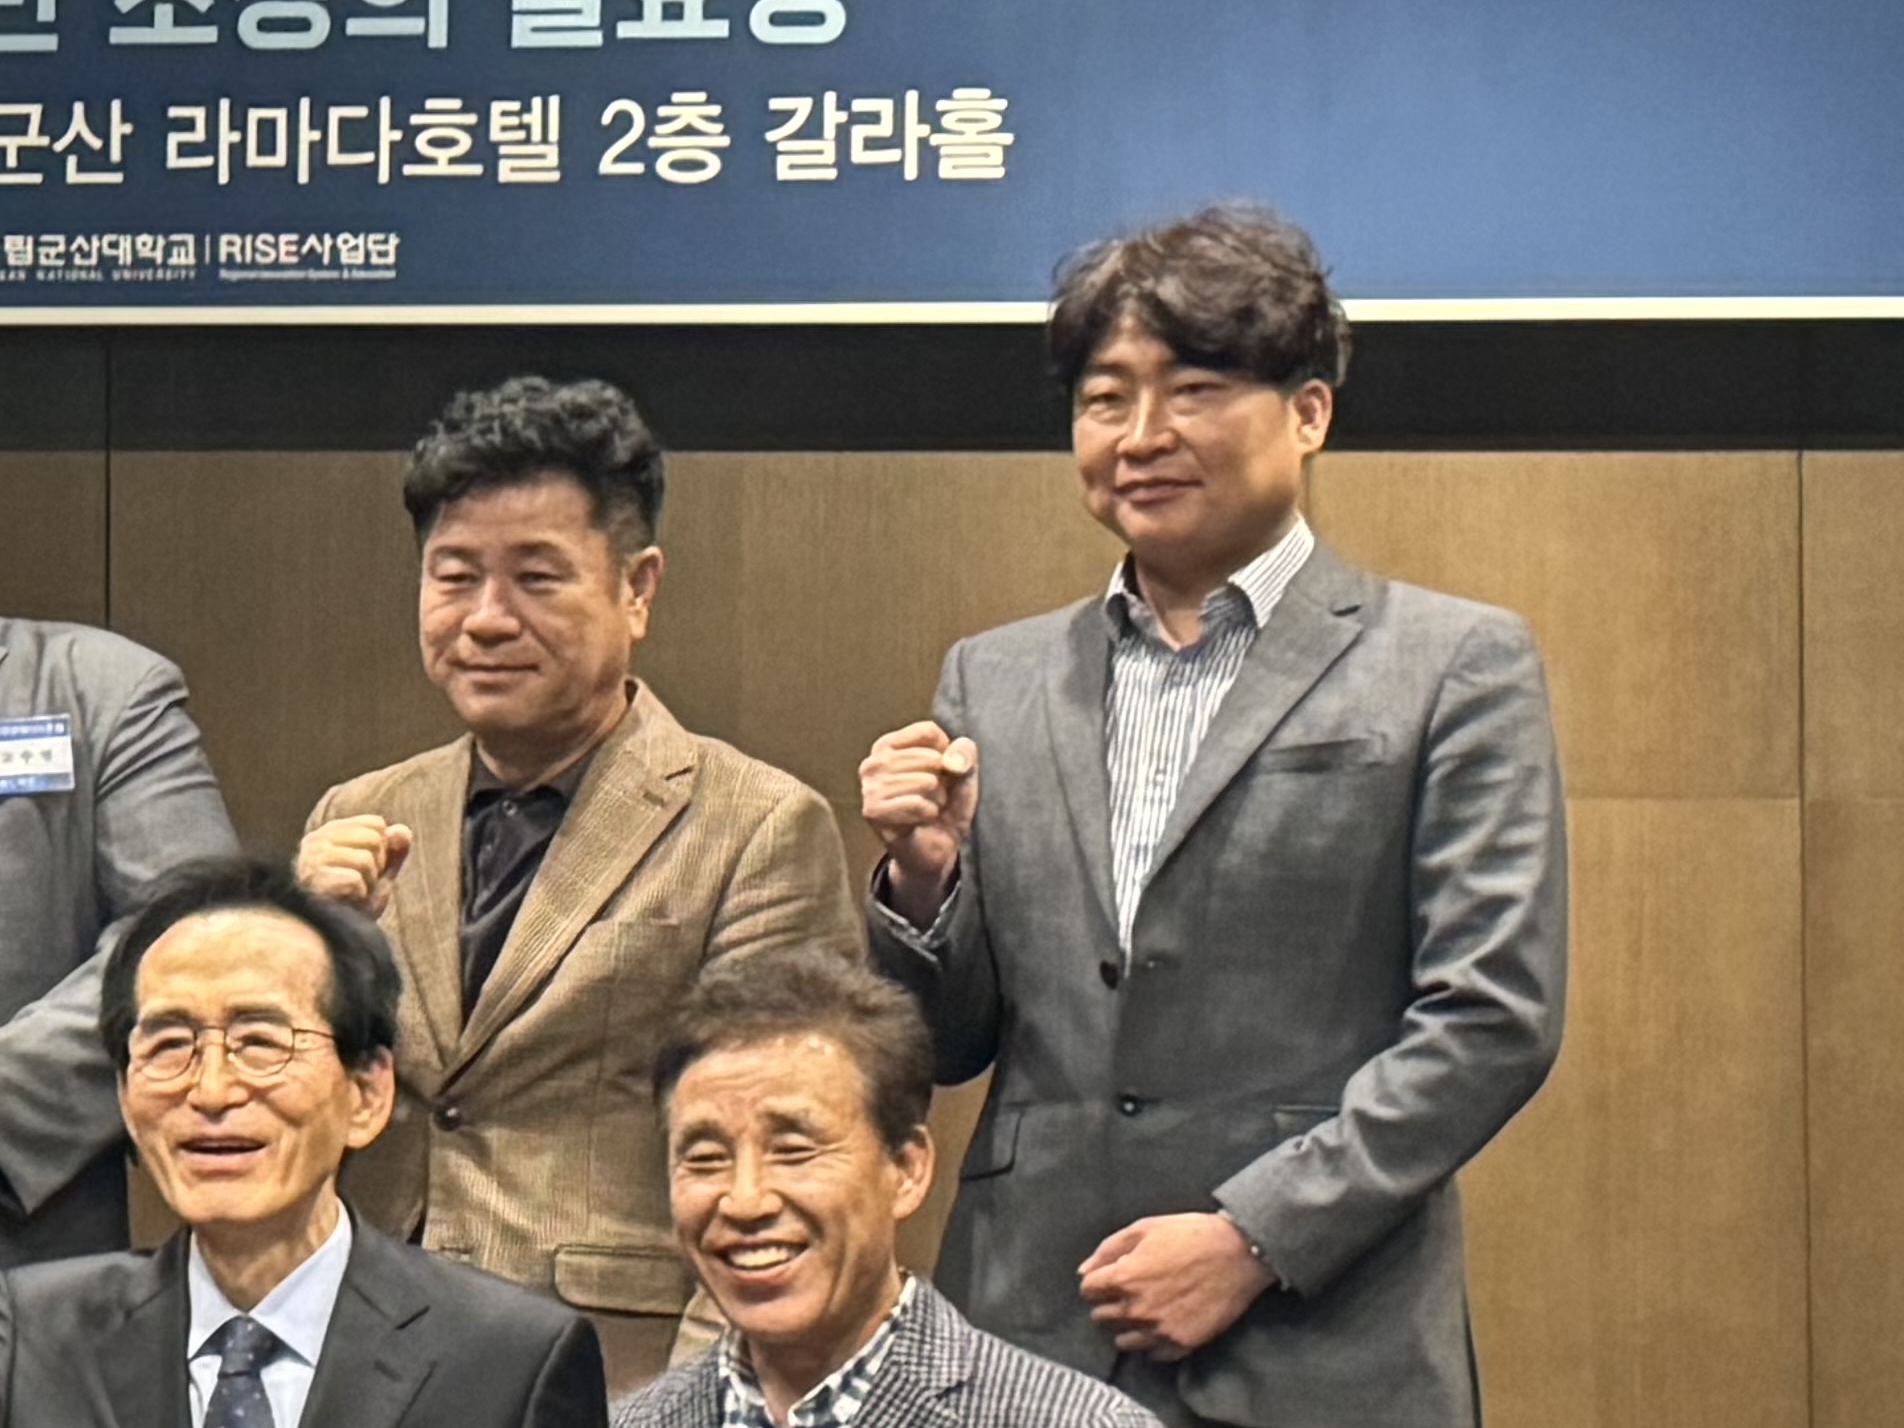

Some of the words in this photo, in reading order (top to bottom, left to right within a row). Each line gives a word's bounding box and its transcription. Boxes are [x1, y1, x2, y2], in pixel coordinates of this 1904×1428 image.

[167, 95, 560, 184] 라마다호텔
[599, 92, 730, 183] 2층
[765, 88, 1014, 180] 갈라홀
[218, 232, 400, 266] RISE사업단
